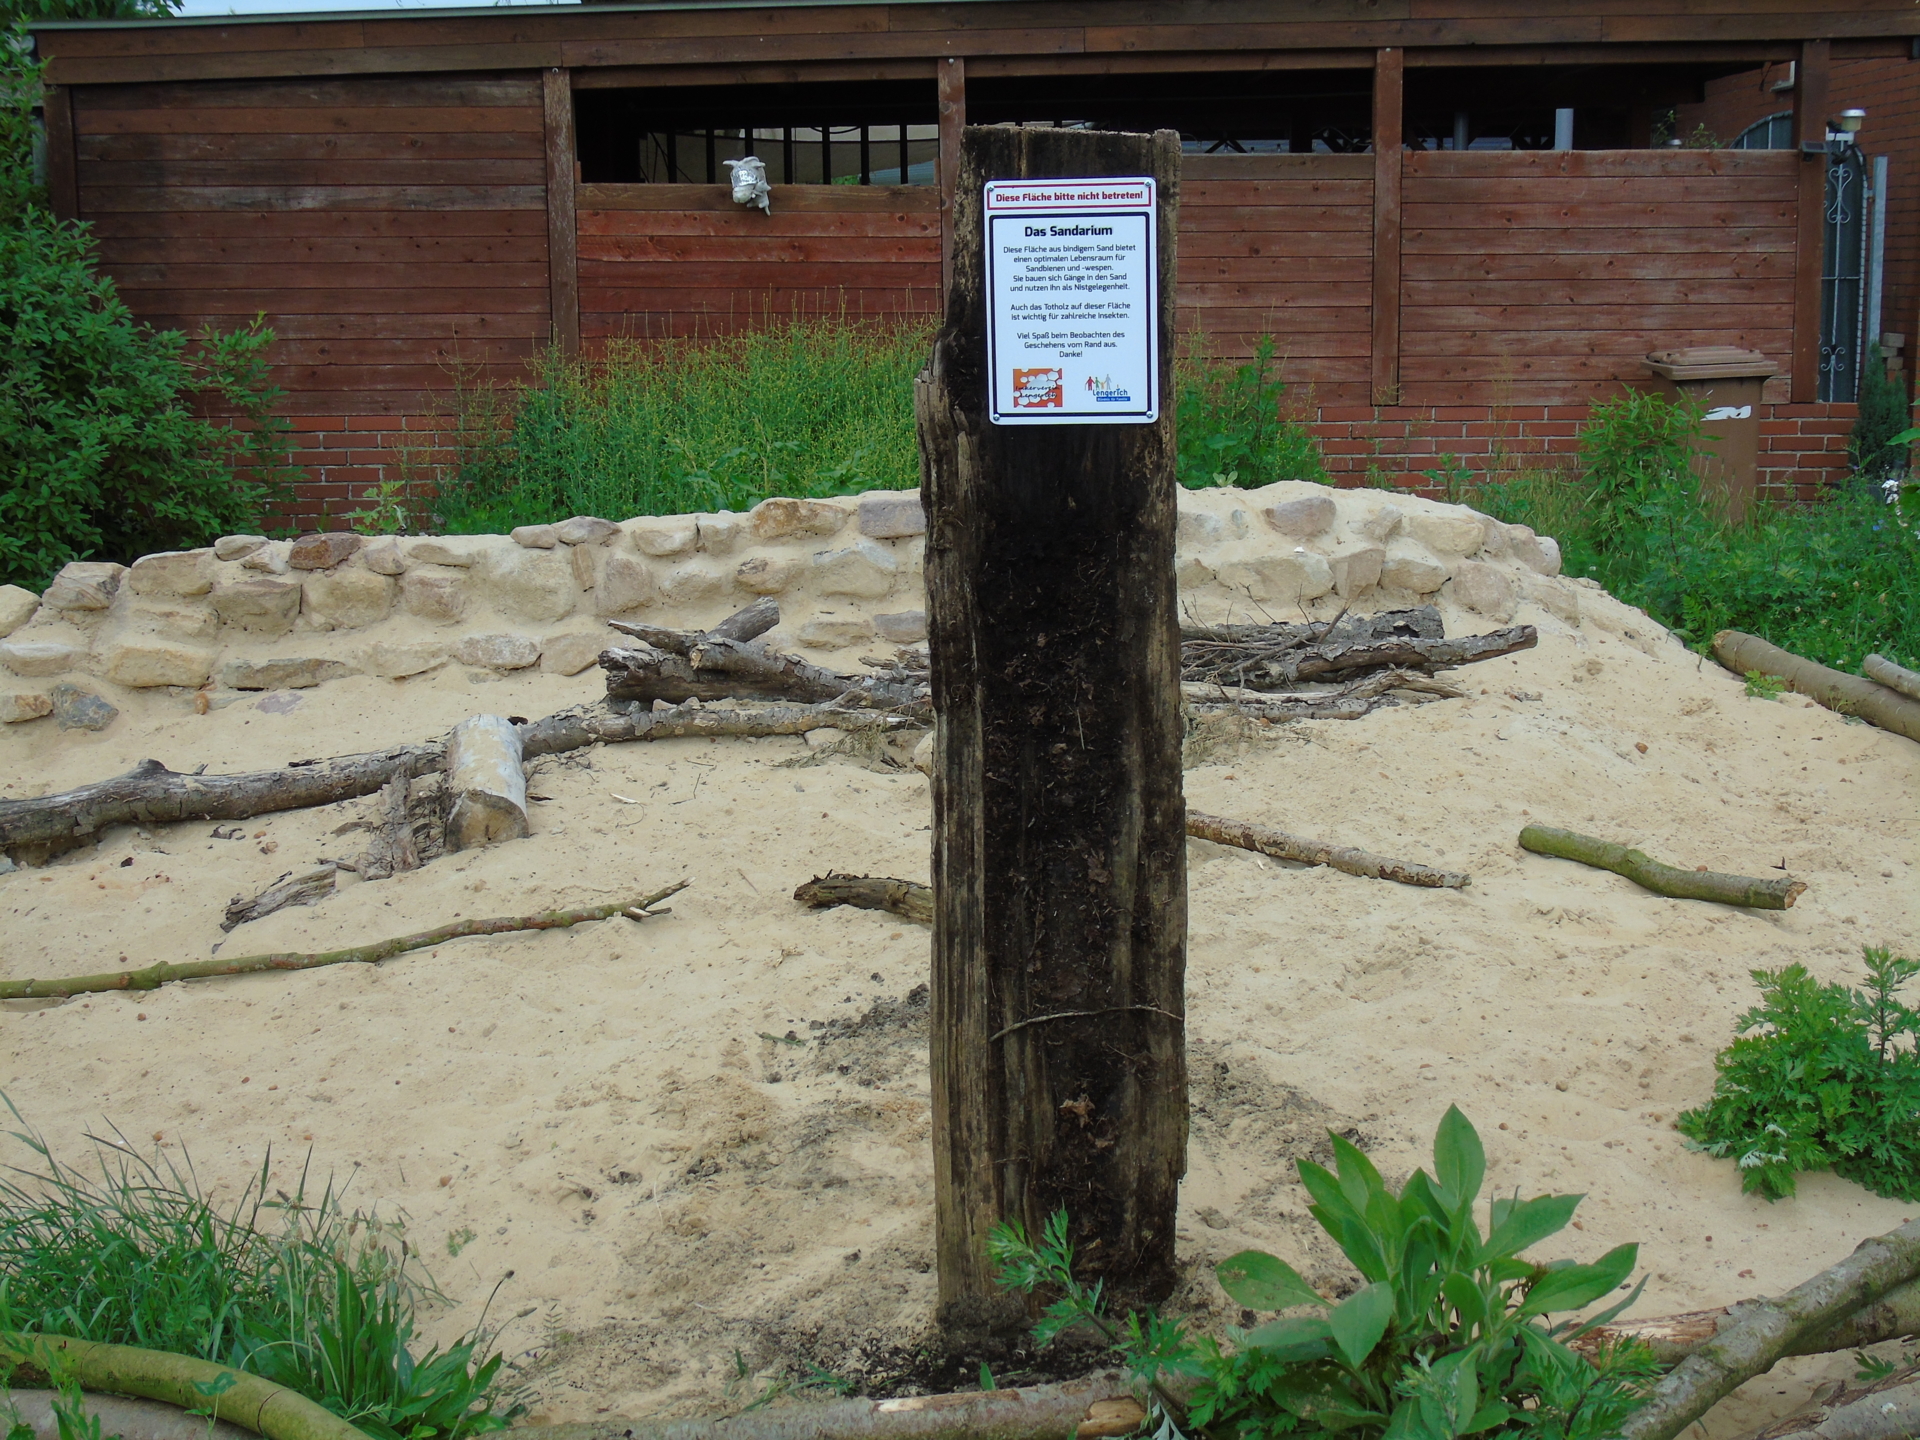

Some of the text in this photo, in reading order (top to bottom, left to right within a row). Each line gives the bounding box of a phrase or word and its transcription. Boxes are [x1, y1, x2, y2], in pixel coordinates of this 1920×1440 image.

[996, 190, 1143, 202] Diese Fläche bitte nicht betreten!
[1024, 224, 1113, 237] Das Sandarium
[1024, 245, 1047, 253] Fläche
[1063, 245, 1094, 253] bindigem
[1013, 255, 1032, 263] einen
[1033, 255, 1069, 264] optimalen
[1070, 254, 1114, 262] Lebensraum
[1025, 264, 1113, 273] Sandbienen und -wespen.
[1025, 274, 1047, 282] bauen
[1048, 274, 1062, 282] sich
[1063, 274, 1085, 283] Gänge
[1095, 273, 1108, 281] den
[1010, 284, 1023, 292] und
[1050, 283, 1061, 291] ihn
[1062, 283, 1073, 291] als
[1074, 283, 1130, 292] Nistgelegenheit.
[1010, 303, 1028, 311] Auch
[1030, 303, 1042, 311] das
[1070, 302, 1082, 310] auf
[1084, 302, 1106, 310] dieser
[1011, 311, 1129, 322] ist wichtig für zahlreiche Insekten.
[1017, 330, 1125, 340] Viel Spaß beim Beobachten des
[1024, 341, 1065, 349] Geschehens
[1084, 340, 1102, 348] Rand
[1059, 350, 1083, 358] Danke!
